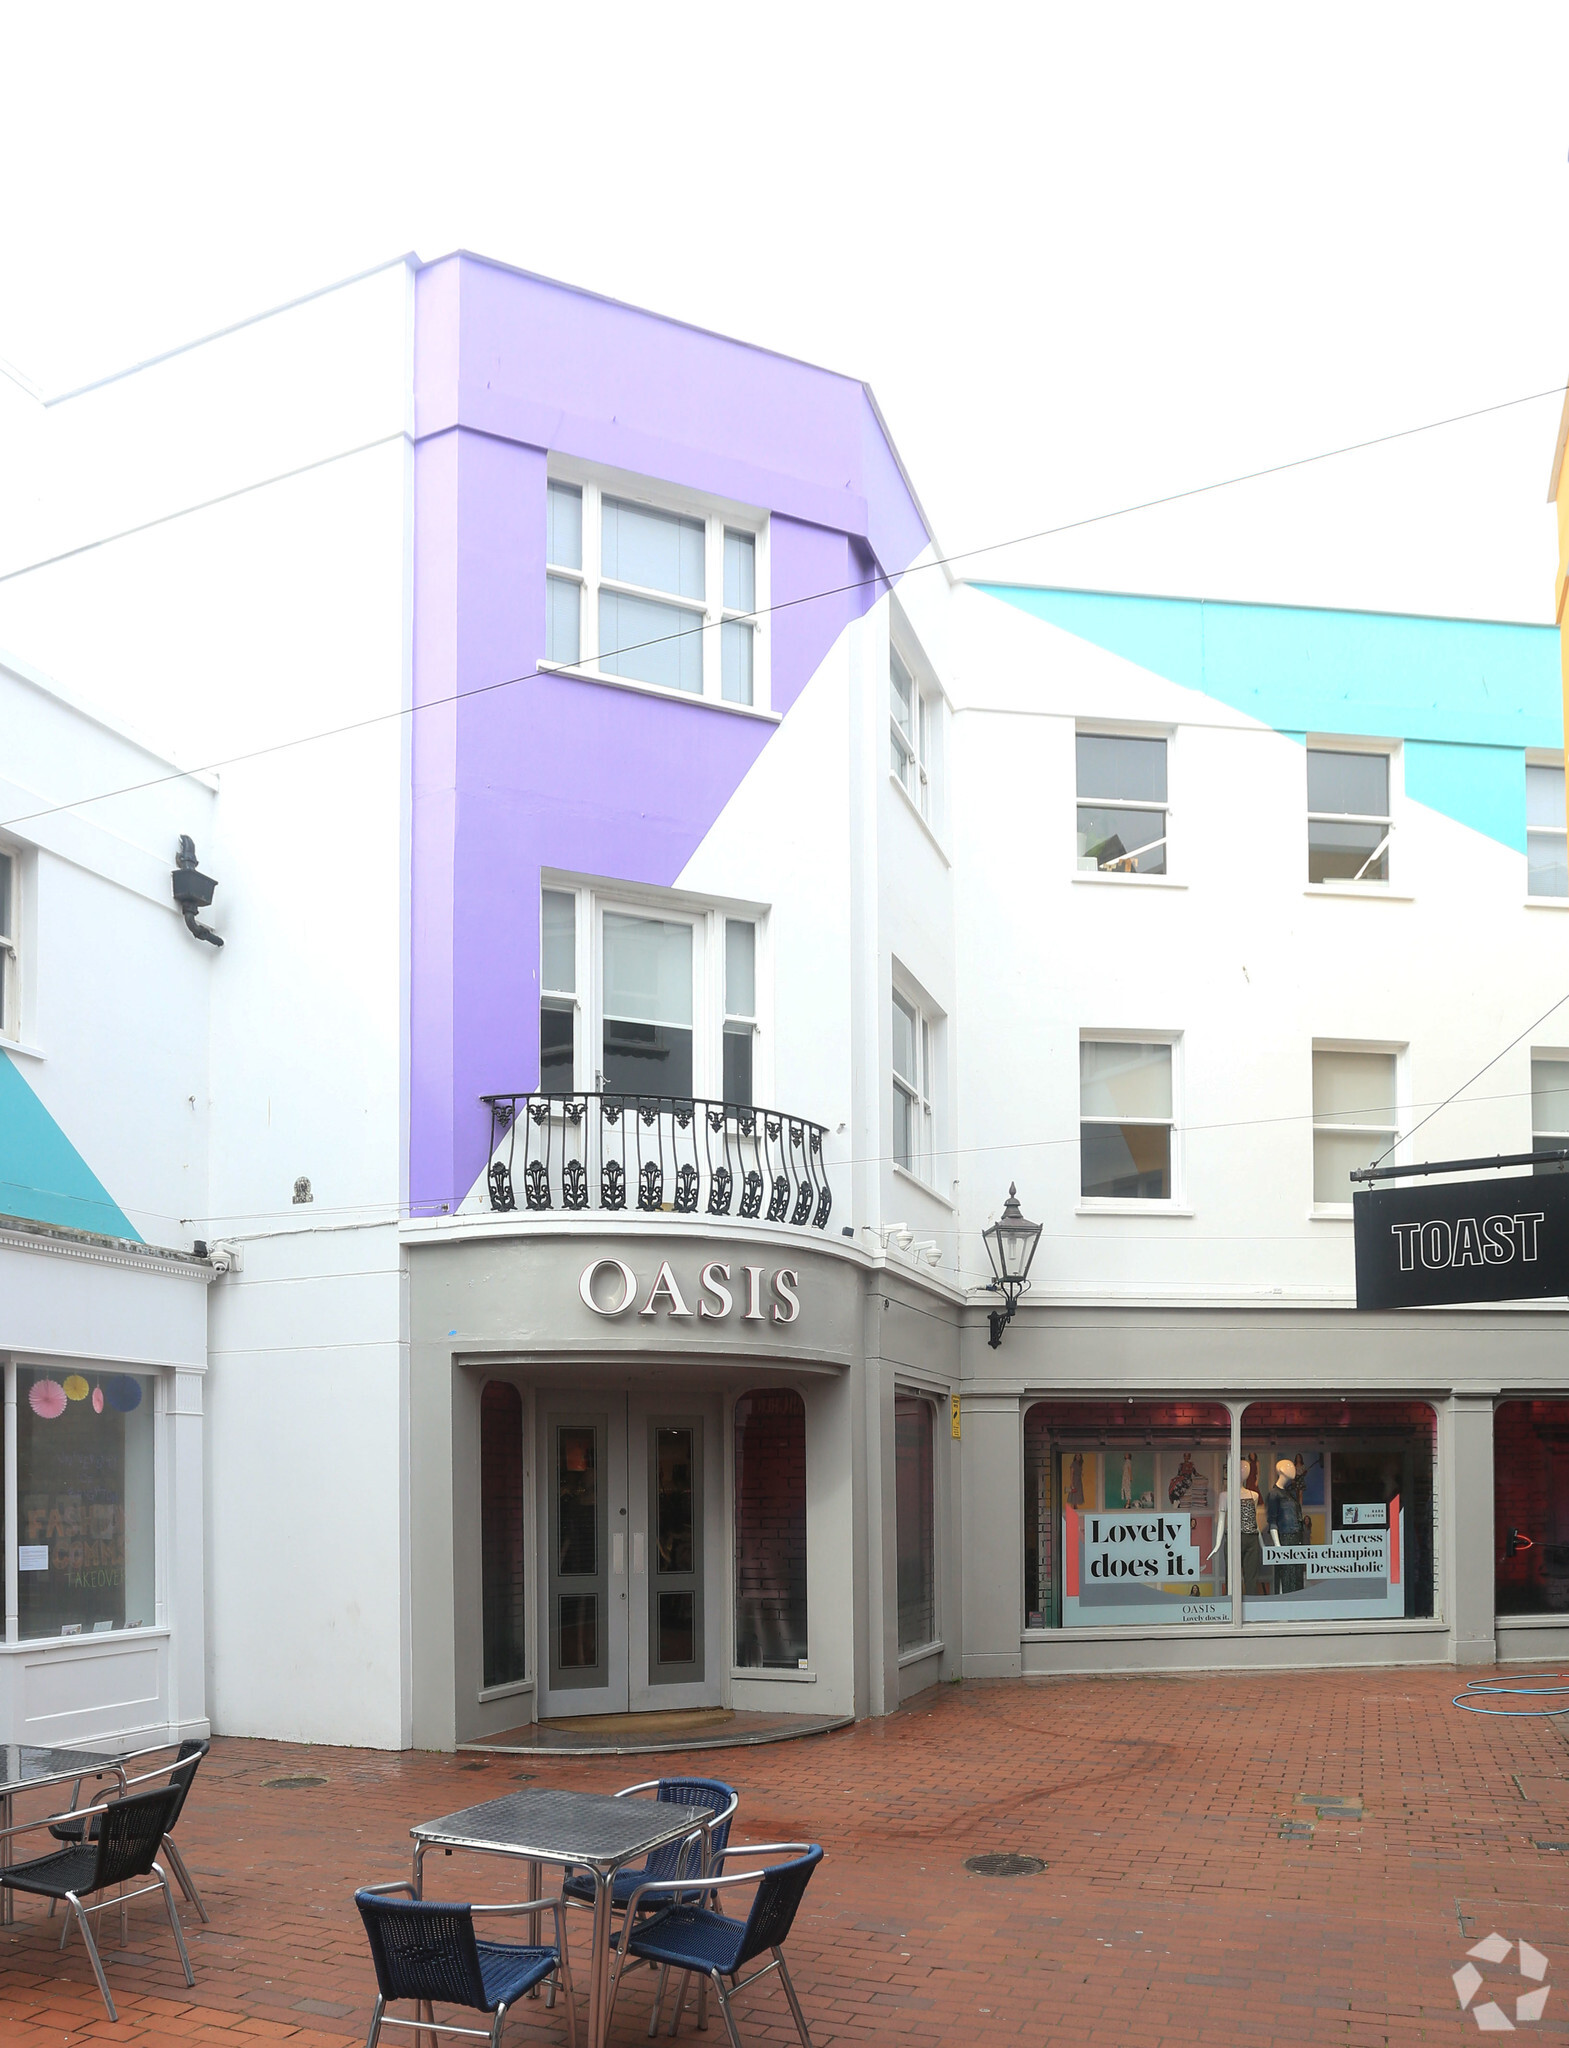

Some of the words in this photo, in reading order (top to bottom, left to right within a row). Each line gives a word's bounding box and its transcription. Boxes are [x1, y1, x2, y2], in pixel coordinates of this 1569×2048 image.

[1391, 1212, 1545, 1271] TOAST
[578, 1257, 800, 1324] OASIS
[1091, 1518, 1182, 1549] Lovely
[1337, 1533, 1383, 1544] Actress
[1090, 1553, 1159, 1578] does
[1167, 1551, 1194, 1576] it.
[1267, 1548, 1318, 1564] Dyslexia
[1321, 1547, 1383, 1561] champion
[64, 1567, 127, 1588] TAKEOVER
[1311, 1561, 1383, 1574] Dressaholic
[1182, 1604, 1216, 1614] OASIS
